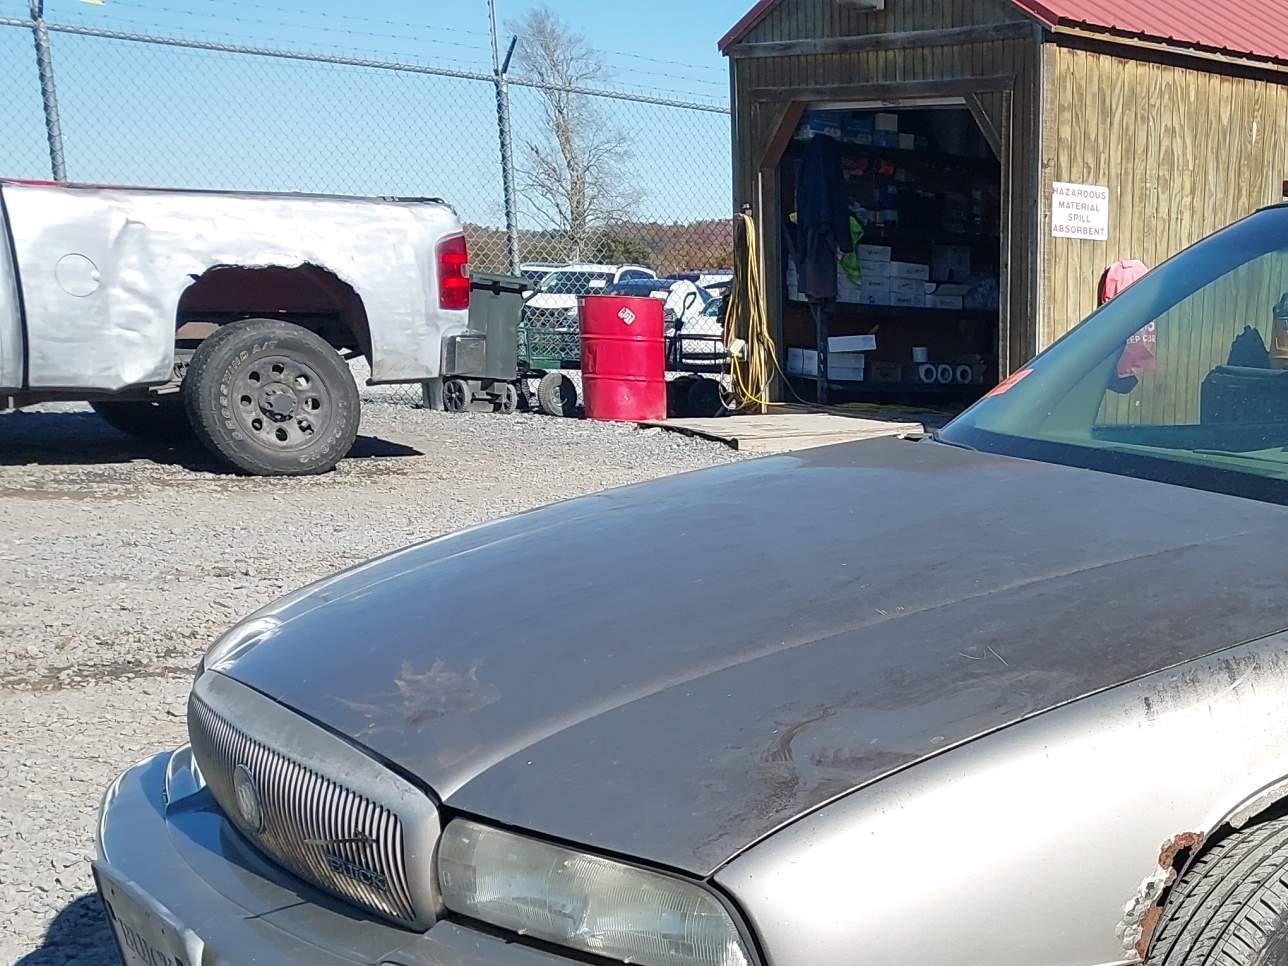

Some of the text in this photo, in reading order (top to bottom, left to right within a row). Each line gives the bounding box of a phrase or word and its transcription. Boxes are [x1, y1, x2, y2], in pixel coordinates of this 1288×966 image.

[1053, 187, 1106, 200] HAZARDOUS
[1058, 200, 1100, 213] MATERIAL
[1067, 213, 1091, 224] SPILL
[1053, 224, 1105, 236] ABSORBENT
[328, 855, 388, 891] BUICK
